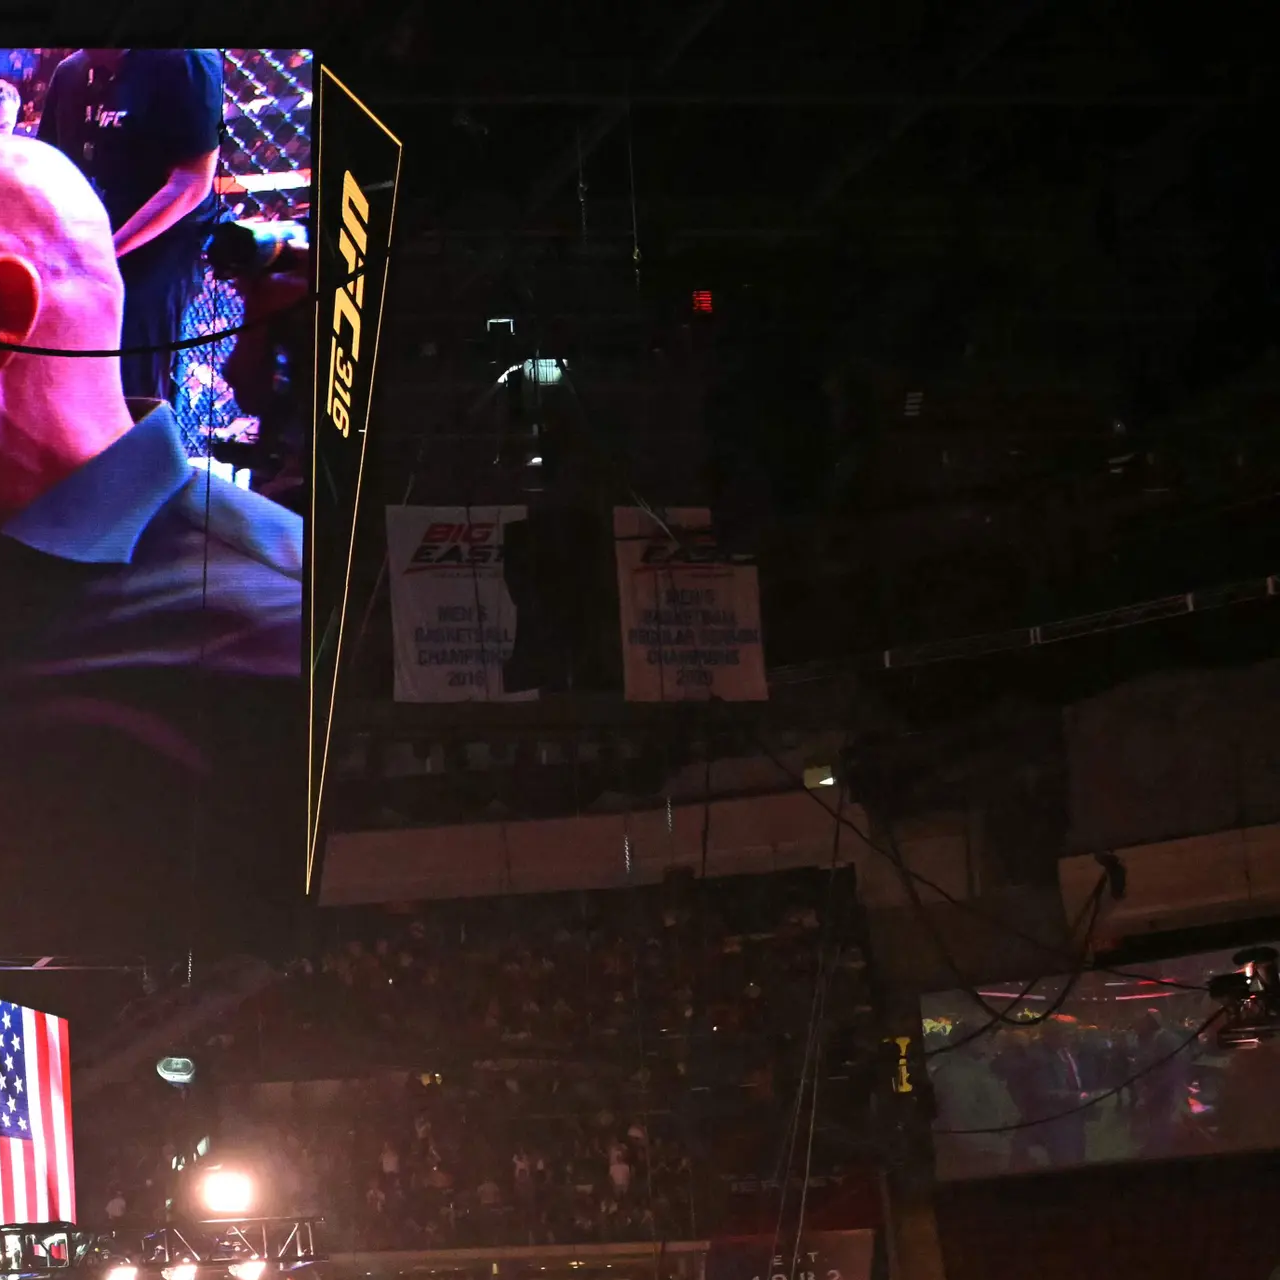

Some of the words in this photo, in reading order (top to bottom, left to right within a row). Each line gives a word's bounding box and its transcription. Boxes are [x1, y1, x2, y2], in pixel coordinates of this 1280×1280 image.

[334, 169, 370, 363] UFC
[332, 346, 354, 439] 316
[423, 523, 498, 543] BIG
